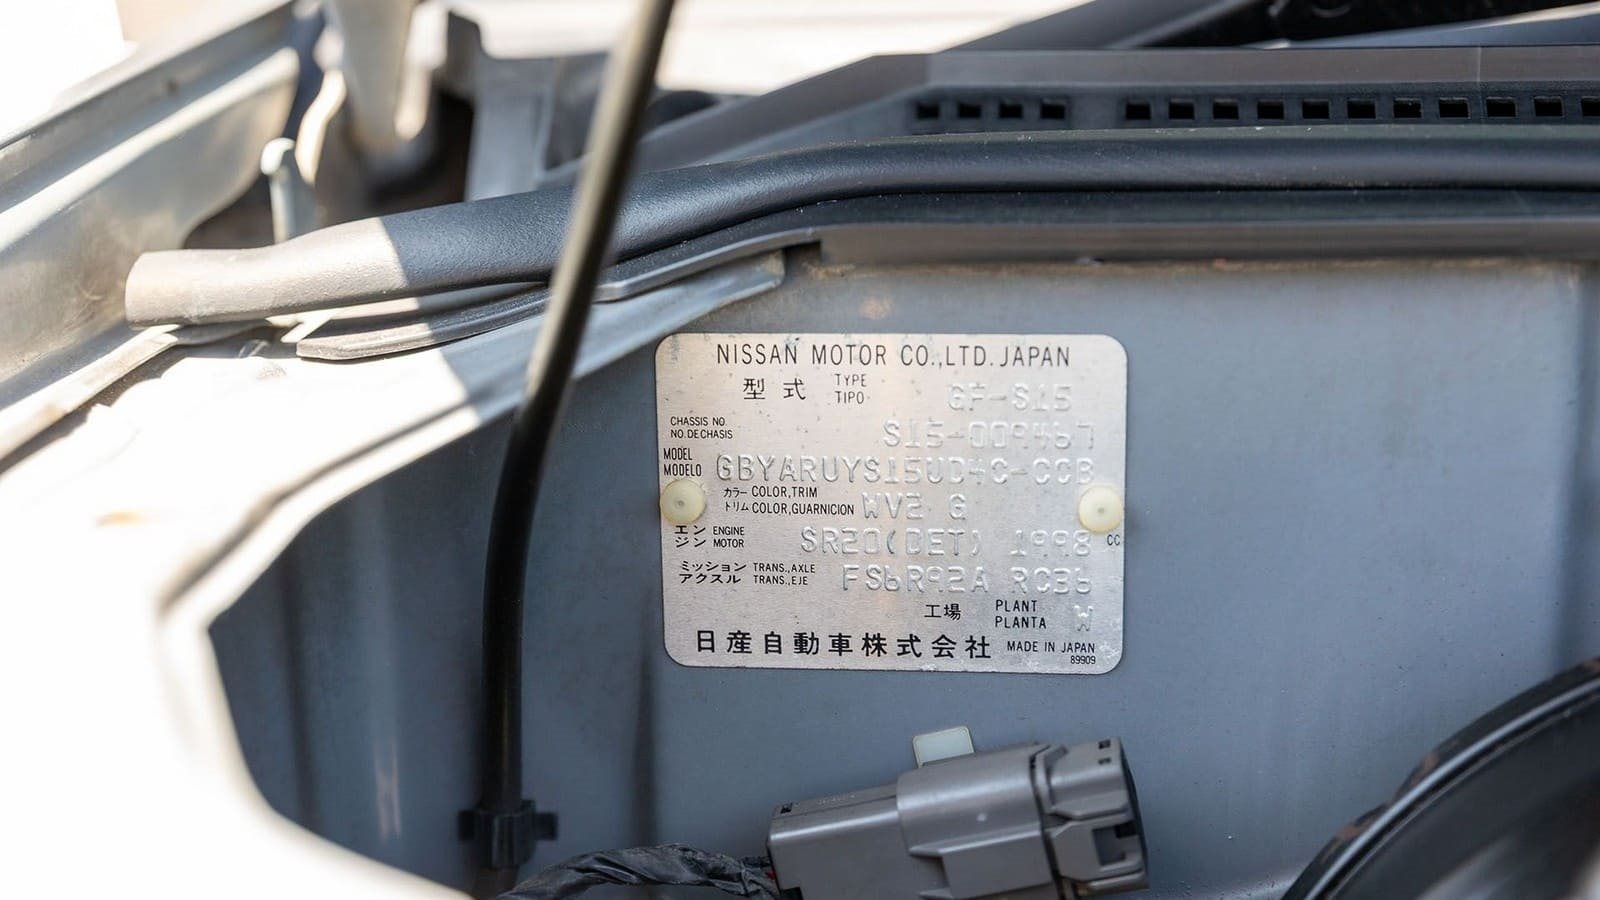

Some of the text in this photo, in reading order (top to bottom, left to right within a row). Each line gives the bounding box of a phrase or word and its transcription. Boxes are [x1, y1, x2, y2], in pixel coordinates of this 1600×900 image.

[717, 343, 797, 365] NISSAN
[812, 344, 887, 366] MOTOR
[999, 346, 1070, 367] JAPAN
[835, 374, 867, 388] TYPE
[835, 391, 865, 404] TIPO
[948, 383, 1072, 411] GF-S15
[670, 416, 709, 427] CHASSIS
[687, 429, 699, 439] DE
[700, 429, 733, 439] CHASIS
[883, 419, 1095, 449] S15-009467
[663, 447, 693, 461] MODEL
[663, 463, 702, 477] MODELO
[724, 487, 748, 498] カラー
[751, 486, 818, 499] COLOR,TRIM
[724, 502, 749, 512] トリム
[751, 502, 855, 516] COLOR,GUARNICION
[862, 492, 967, 520] WV2 G
[712, 526, 745, 536] ENGINE
[713, 538, 745, 548] MOTOR
[800, 527, 1092, 557] SR20(DET) 1998
[1106, 534, 1121, 546] CC
[680, 560, 747, 572] ミッション
[753, 562, 816, 574] TRANS.,AXLE
[679, 573, 742, 585] アクスル
[753, 575, 809, 586] TRANS.,EJE
[842, 564, 1092, 595] FS6R92A RC36
[924, 604, 962, 621] 工場
[995, 600, 1038, 612] PLANT
[995, 616, 1047, 629] PLANTA
[1073, 605, 1094, 632] W
[697, 629, 992, 659] 日産自動車株式会社
[1007, 641, 1095, 653] MADE IN JAPAN
[1070, 655, 1096, 665] 89909
